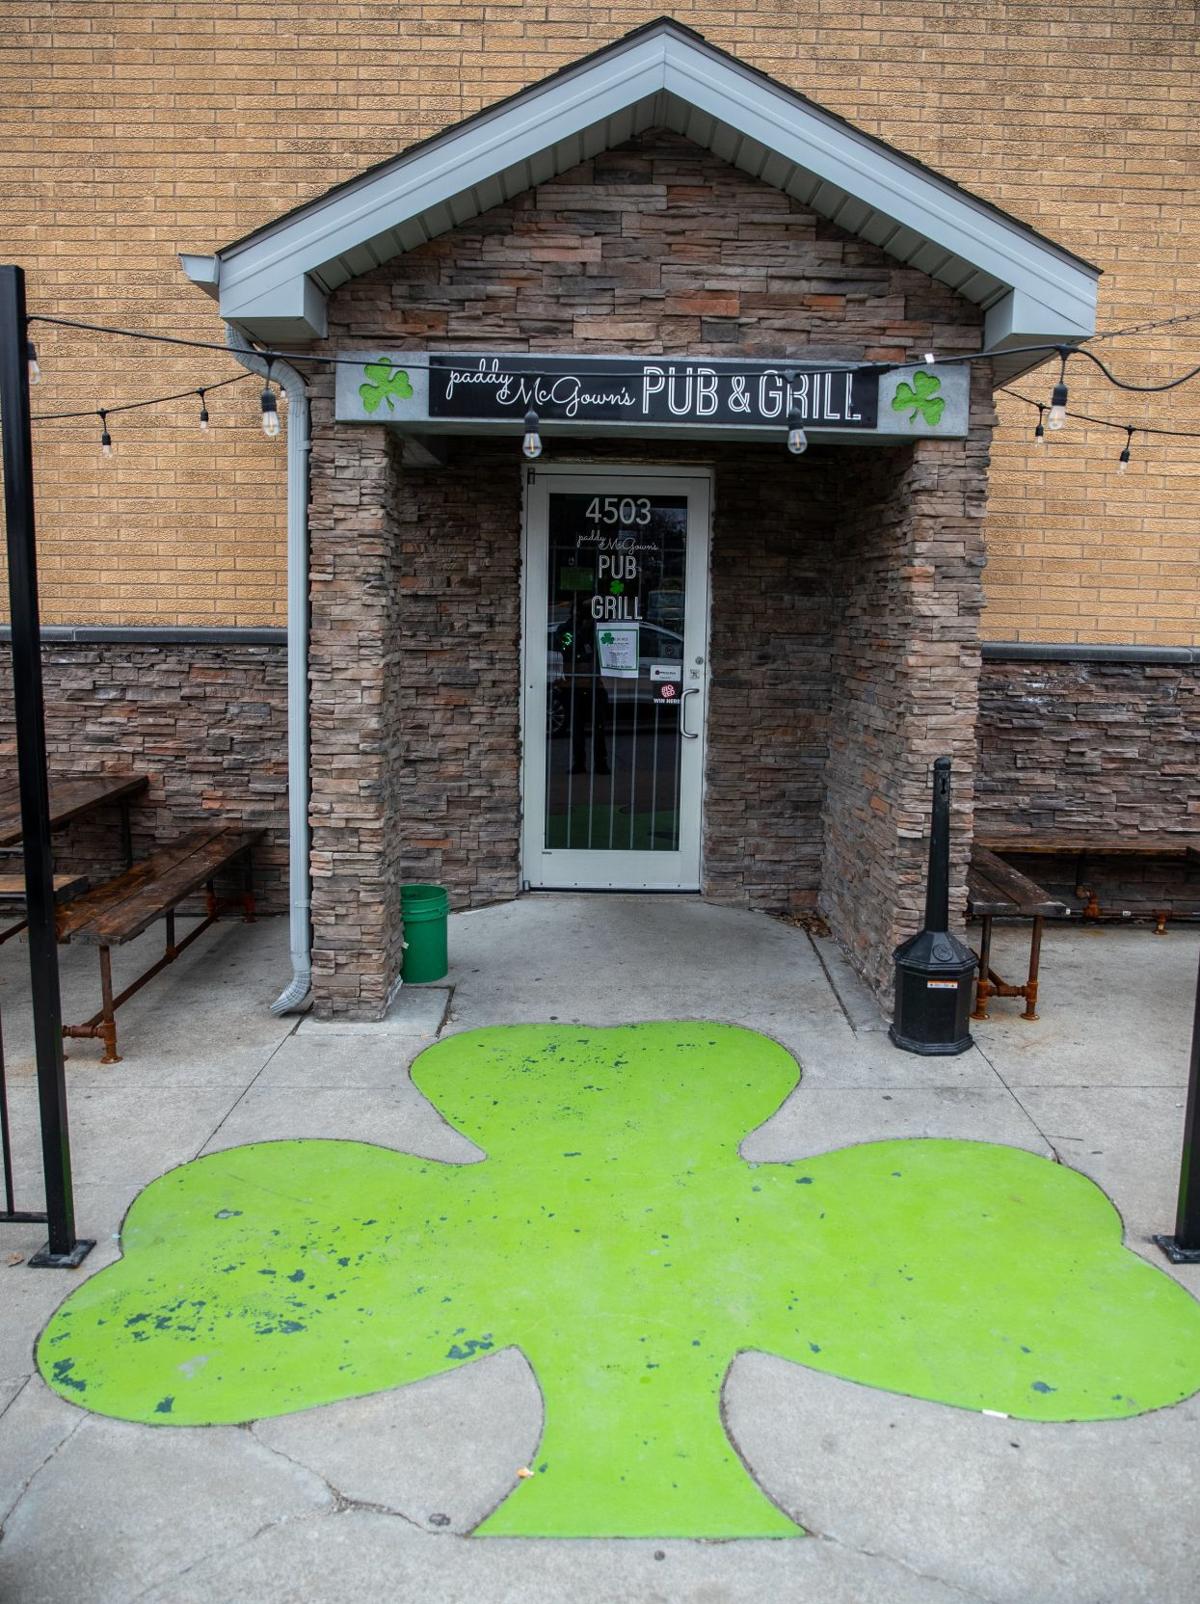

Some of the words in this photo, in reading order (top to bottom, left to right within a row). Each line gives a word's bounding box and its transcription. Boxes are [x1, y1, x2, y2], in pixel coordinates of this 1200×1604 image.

[446, 358, 513, 400] paddy
[496, 376, 636, 416] McGown's
[642, 366, 718, 415] PUB
[728, 374, 751, 412] &
[759, 370, 861, 420] GRILL
[585, 497, 651, 525] 4503
[577, 530, 606, 548] paddy
[598, 555, 637, 579] PUB
[591, 596, 643, 620] GRILL
